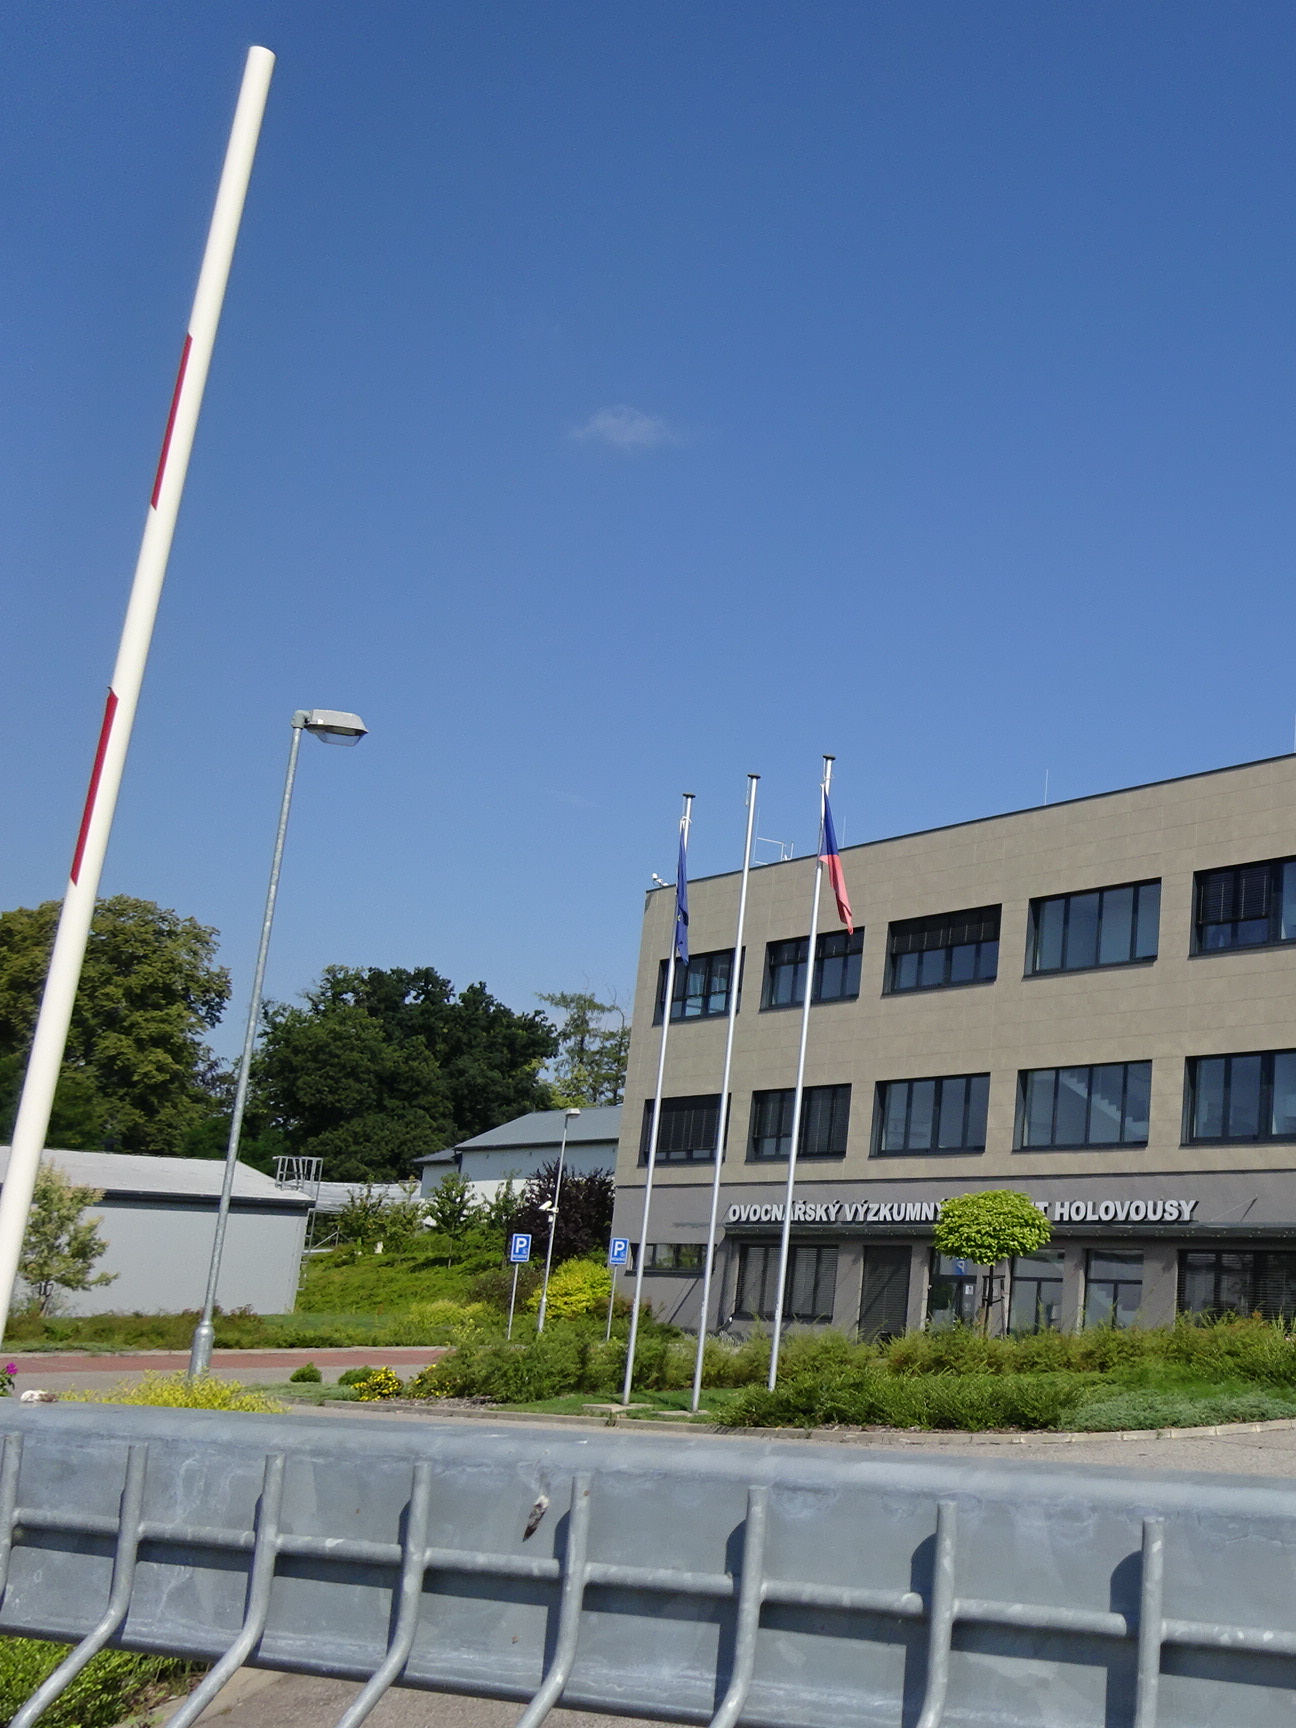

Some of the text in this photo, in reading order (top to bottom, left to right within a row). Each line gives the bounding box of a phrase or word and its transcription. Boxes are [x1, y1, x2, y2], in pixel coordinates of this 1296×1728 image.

[1054, 1200, 1196, 1222] HOLOVOUSY
[515, 1237, 527, 1254] P
[614, 1241, 625, 1256] P
